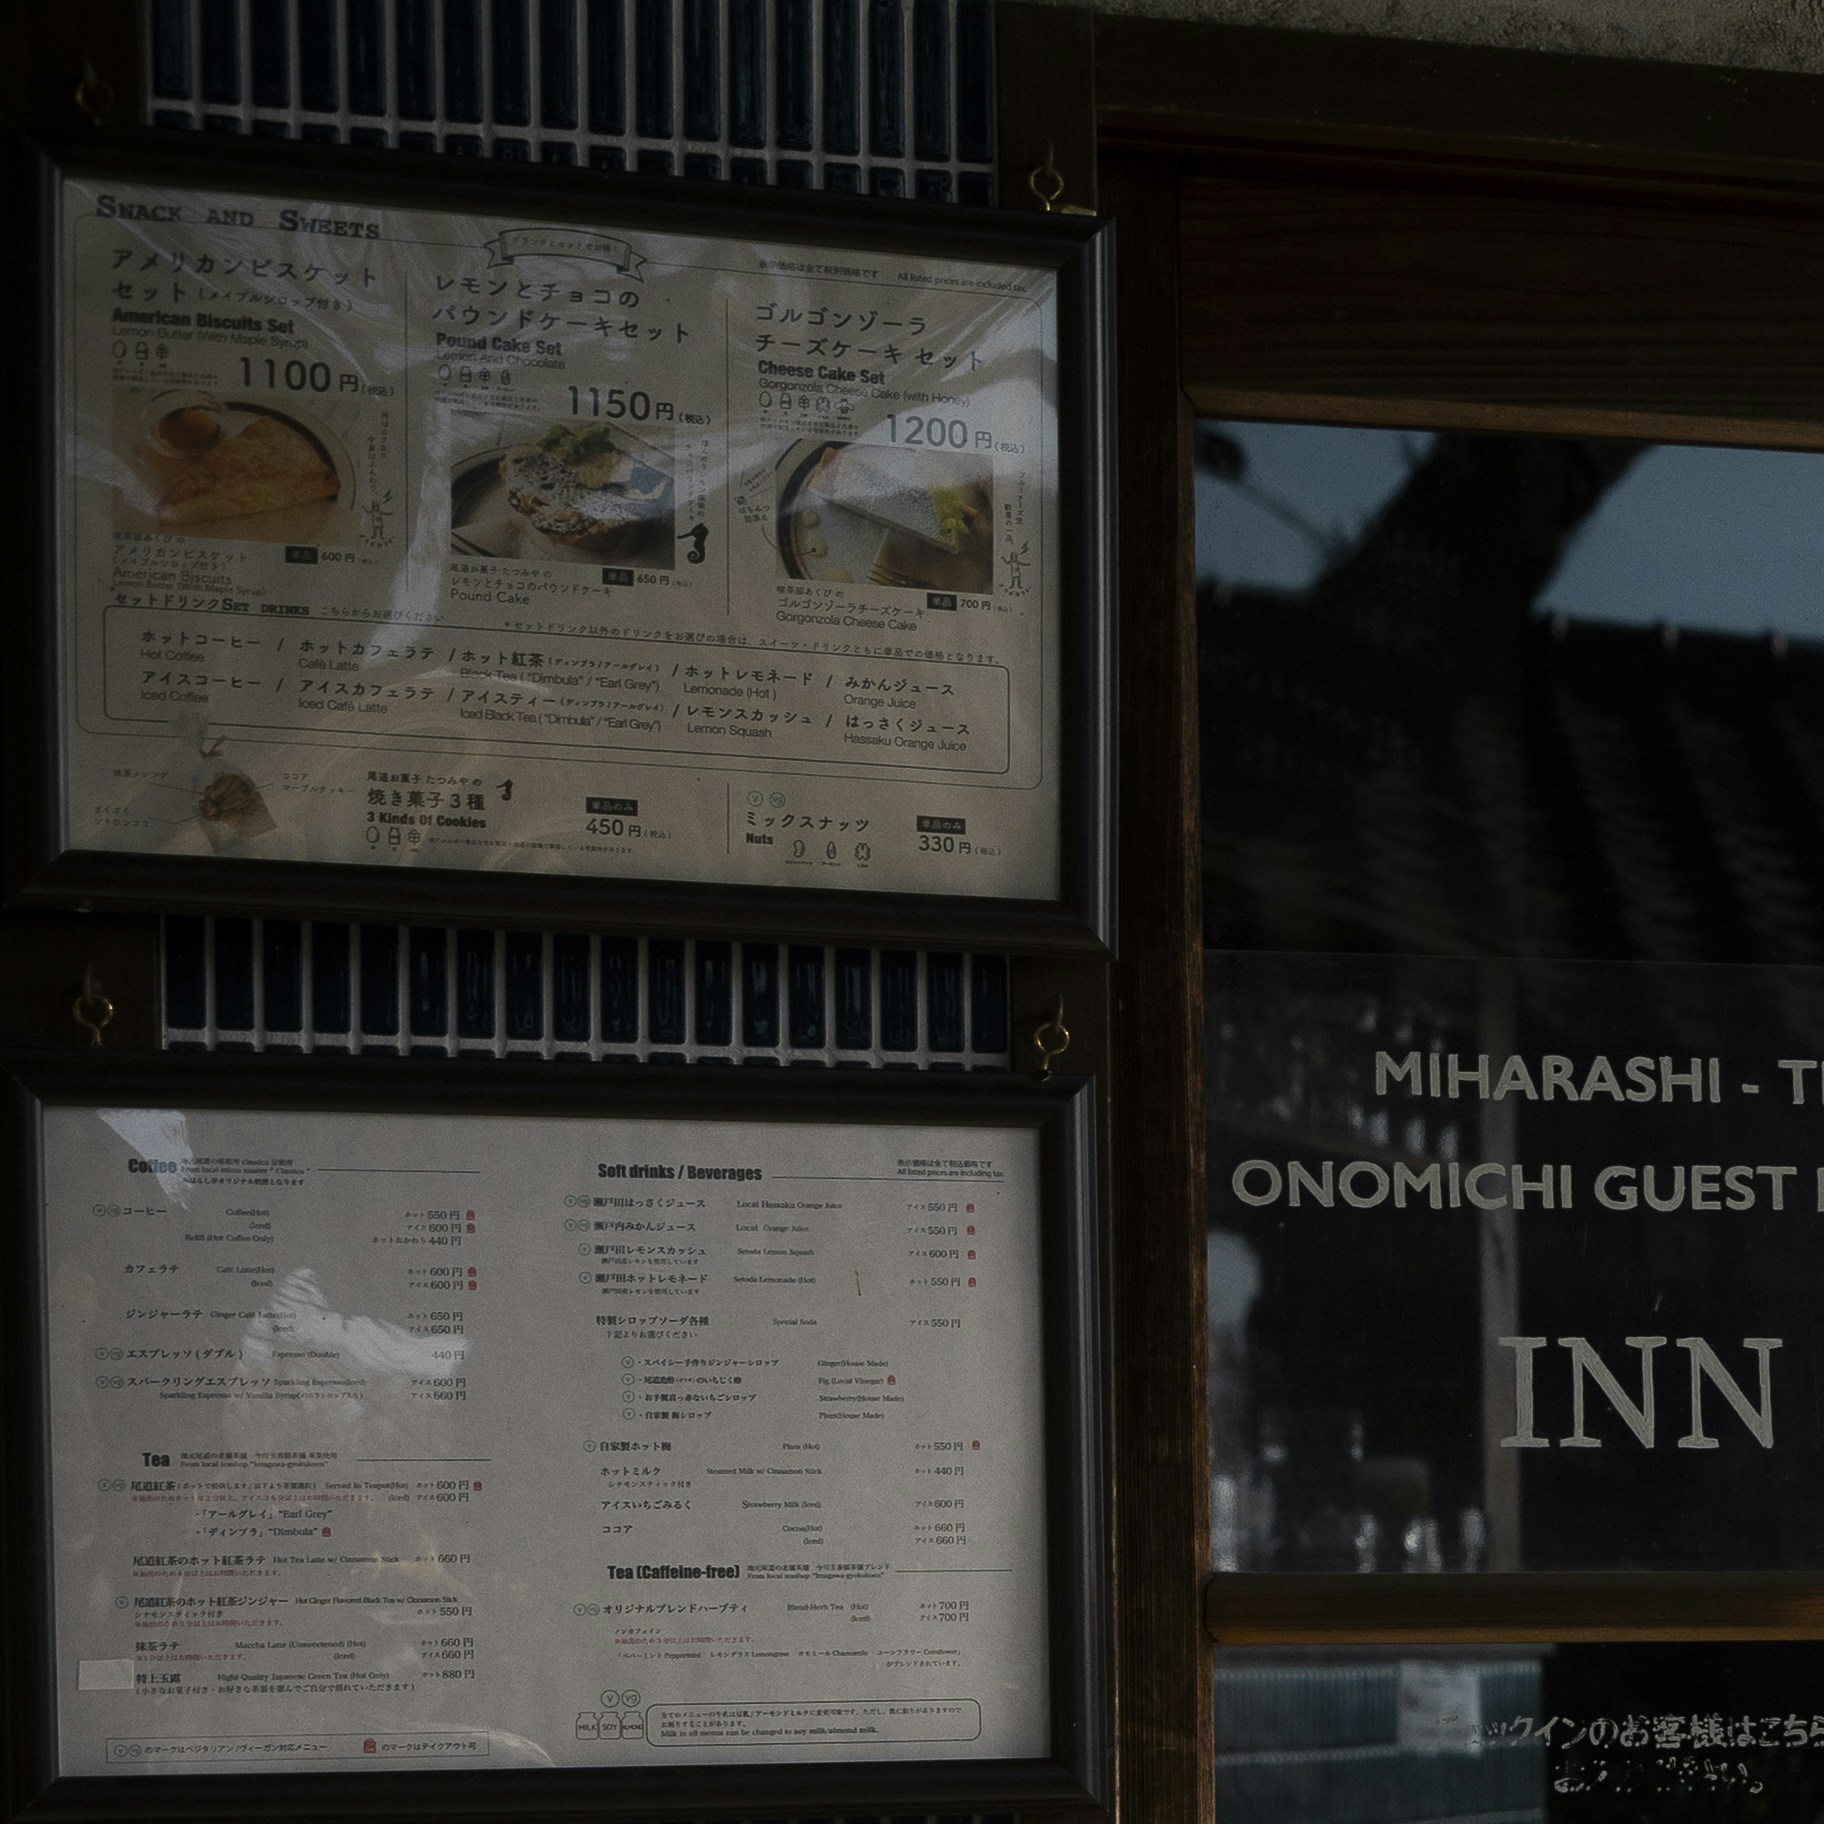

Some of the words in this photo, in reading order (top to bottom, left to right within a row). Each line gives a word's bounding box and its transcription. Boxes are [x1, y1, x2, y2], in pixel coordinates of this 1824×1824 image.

[112, 249, 376, 288] アメリカンビスケット
[437, 276, 639, 308] レモンとチョコの
[112, 307, 190, 327] American
[197, 313, 262, 331] Biscuits
[268, 318, 294, 334] Set
[432, 306, 688, 343] パウンドケーキセット
[757, 303, 926, 335] ゴルゴンゾーラ
[437, 333, 486, 350] Pound
[492, 338, 530, 354] Cake
[536, 341, 562, 356] Set
[758, 360, 812, 378] Cheese
[818, 364, 856, 382] Cake
[861, 369, 885, 385] Set
[141, 630, 260, 649] ホットコーヒー
[141, 649, 162, 661] Hot
[166, 650, 204, 664] Coffee
[142, 670, 261, 689] アイスコーヒー
[845, 674, 954, 695] みかんジュース
[844, 694, 884, 709] Orange
[888, 696, 917, 710] Juice
[846, 715, 970, 736] はっさくジュース
[367, 811, 375, 823] 3
[379, 812, 415, 825] Kinds
[436, 815, 486, 829] Cookies
[747, 812, 870, 833] ミックスナッツ
[746, 832, 773, 846] Nuts
[1375, 1050, 1721, 1105] MIHARASHI
[128, 1158, 177, 1174] Coffee
[598, 1163, 626, 1179] Soft
[629, 1164, 675, 1180] drinks
[687, 1165, 762, 1181] Beverages
[1232, 1159, 1573, 1210] ONOMICHI
[1594, 1165, 1797, 1212] GUEST
[124, 1264, 178, 1274] カフェラテ
[1498, 1336, 1783, 1449] INN
[143, 1452, 170, 1467] Tea
[607, 1565, 633, 1580] Tea
